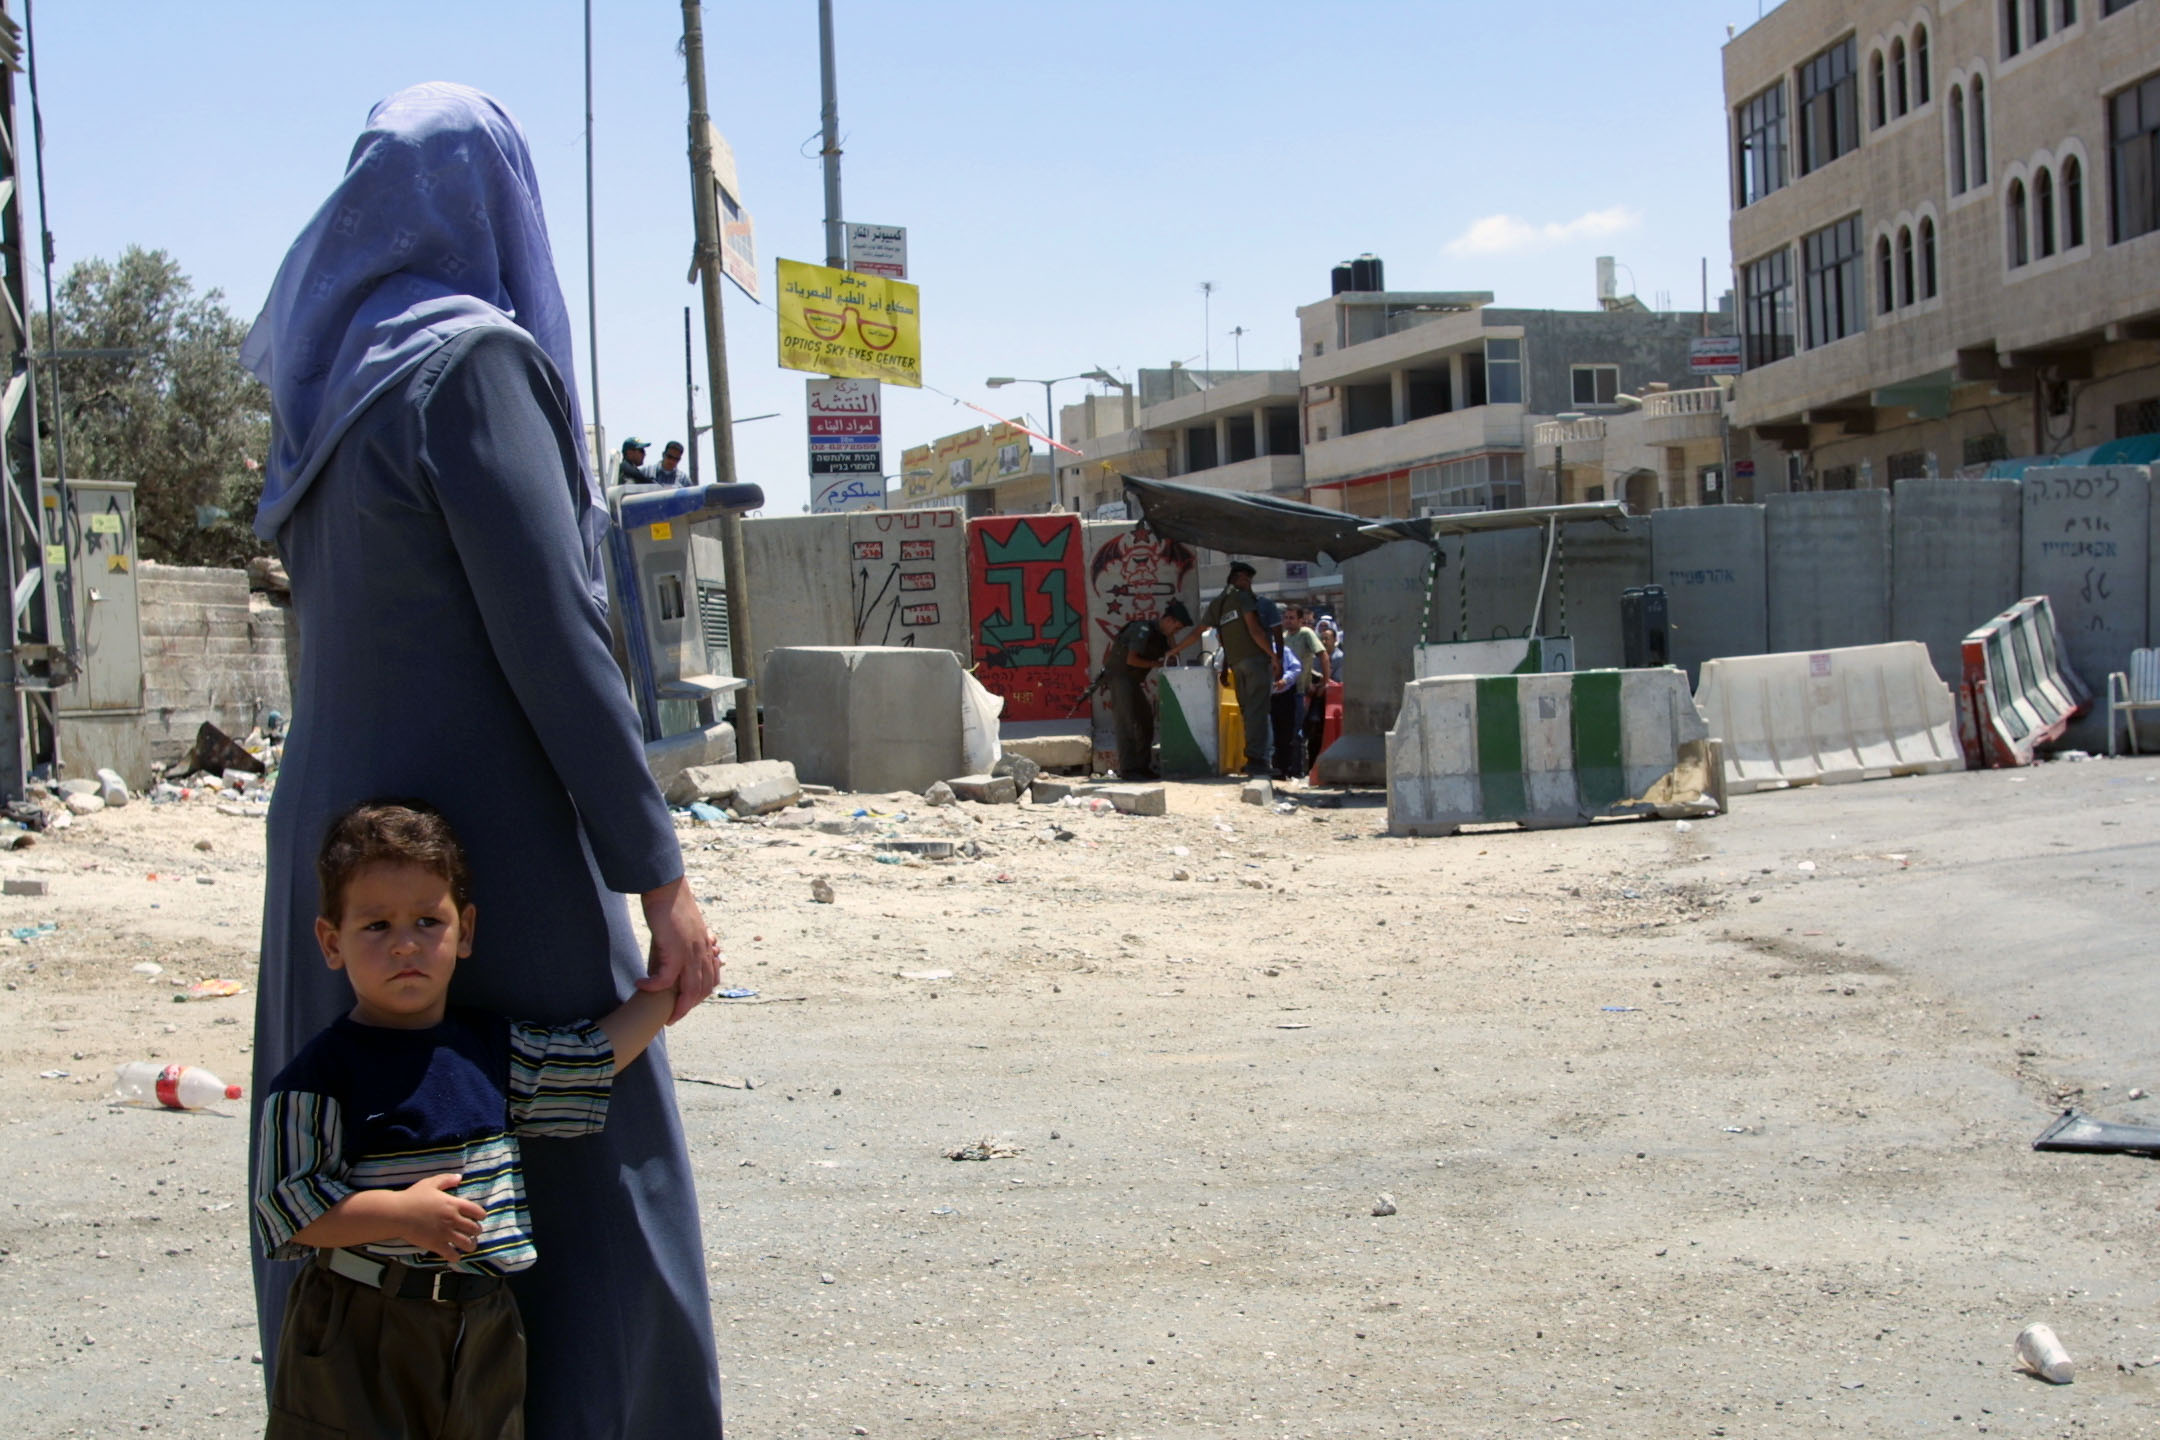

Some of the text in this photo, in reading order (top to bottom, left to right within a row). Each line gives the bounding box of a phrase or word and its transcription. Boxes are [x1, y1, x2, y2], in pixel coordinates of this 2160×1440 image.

[840, 273, 867, 288] مركز
[785, 282, 832, 300] للبصريات
[835, 291, 865, 306] الطبي
[784, 336, 822, 352] OPTICS
[826, 344, 846, 357] SKY
[848, 348, 874, 362] EYES
[876, 352, 916, 369] CENTER
[835, 382, 859, 394] شركة
[811, 392, 878, 414] النتشة
[817, 419, 874, 434] لمواد البناء
[854, 453, 877, 462] חברת
[828, 481, 881, 504] سلكوم
